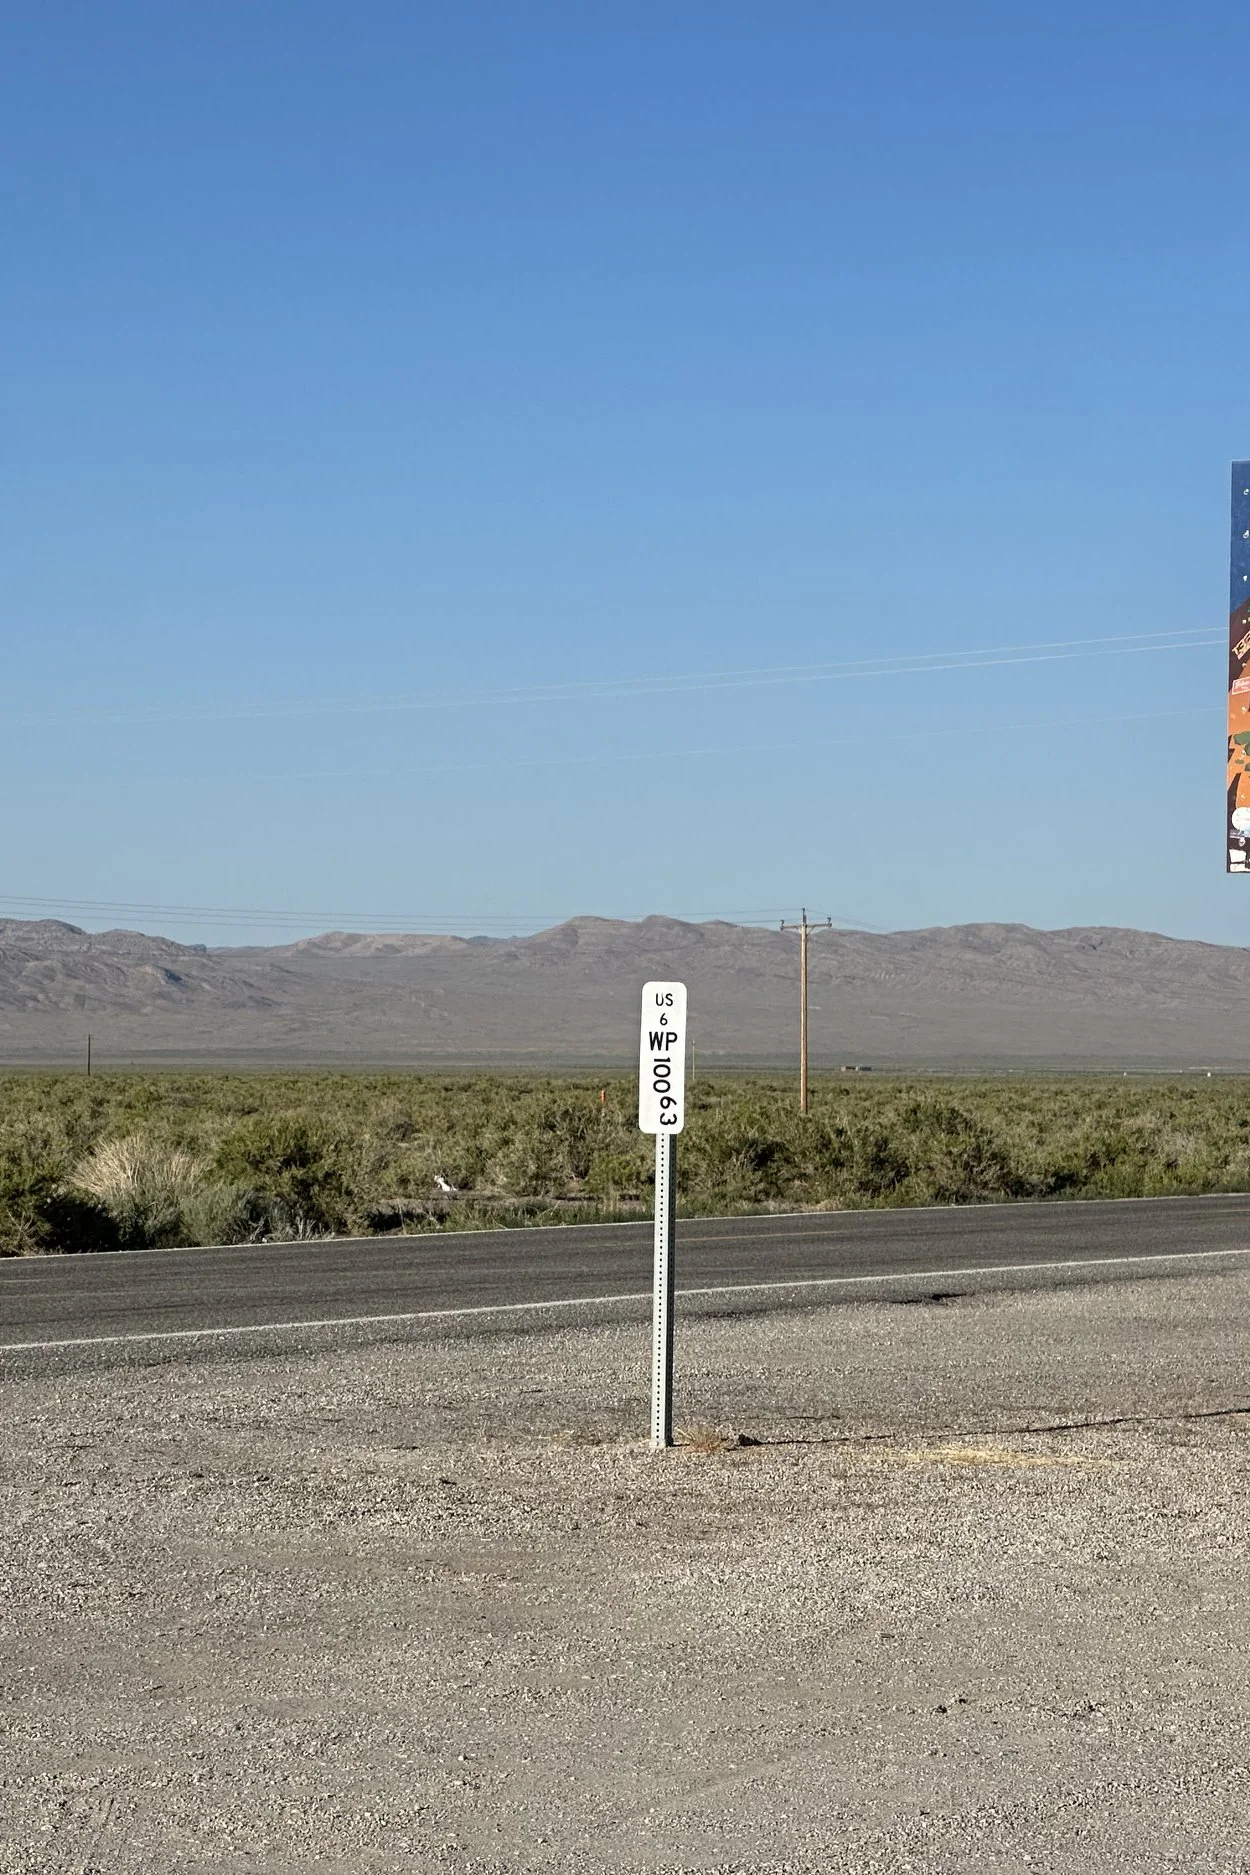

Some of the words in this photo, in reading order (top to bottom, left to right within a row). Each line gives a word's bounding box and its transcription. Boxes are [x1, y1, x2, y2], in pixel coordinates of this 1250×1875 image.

[655, 993, 674, 1006] US
[659, 1012, 668, 1026] 6
[649, 1031, 678, 1051] WP
